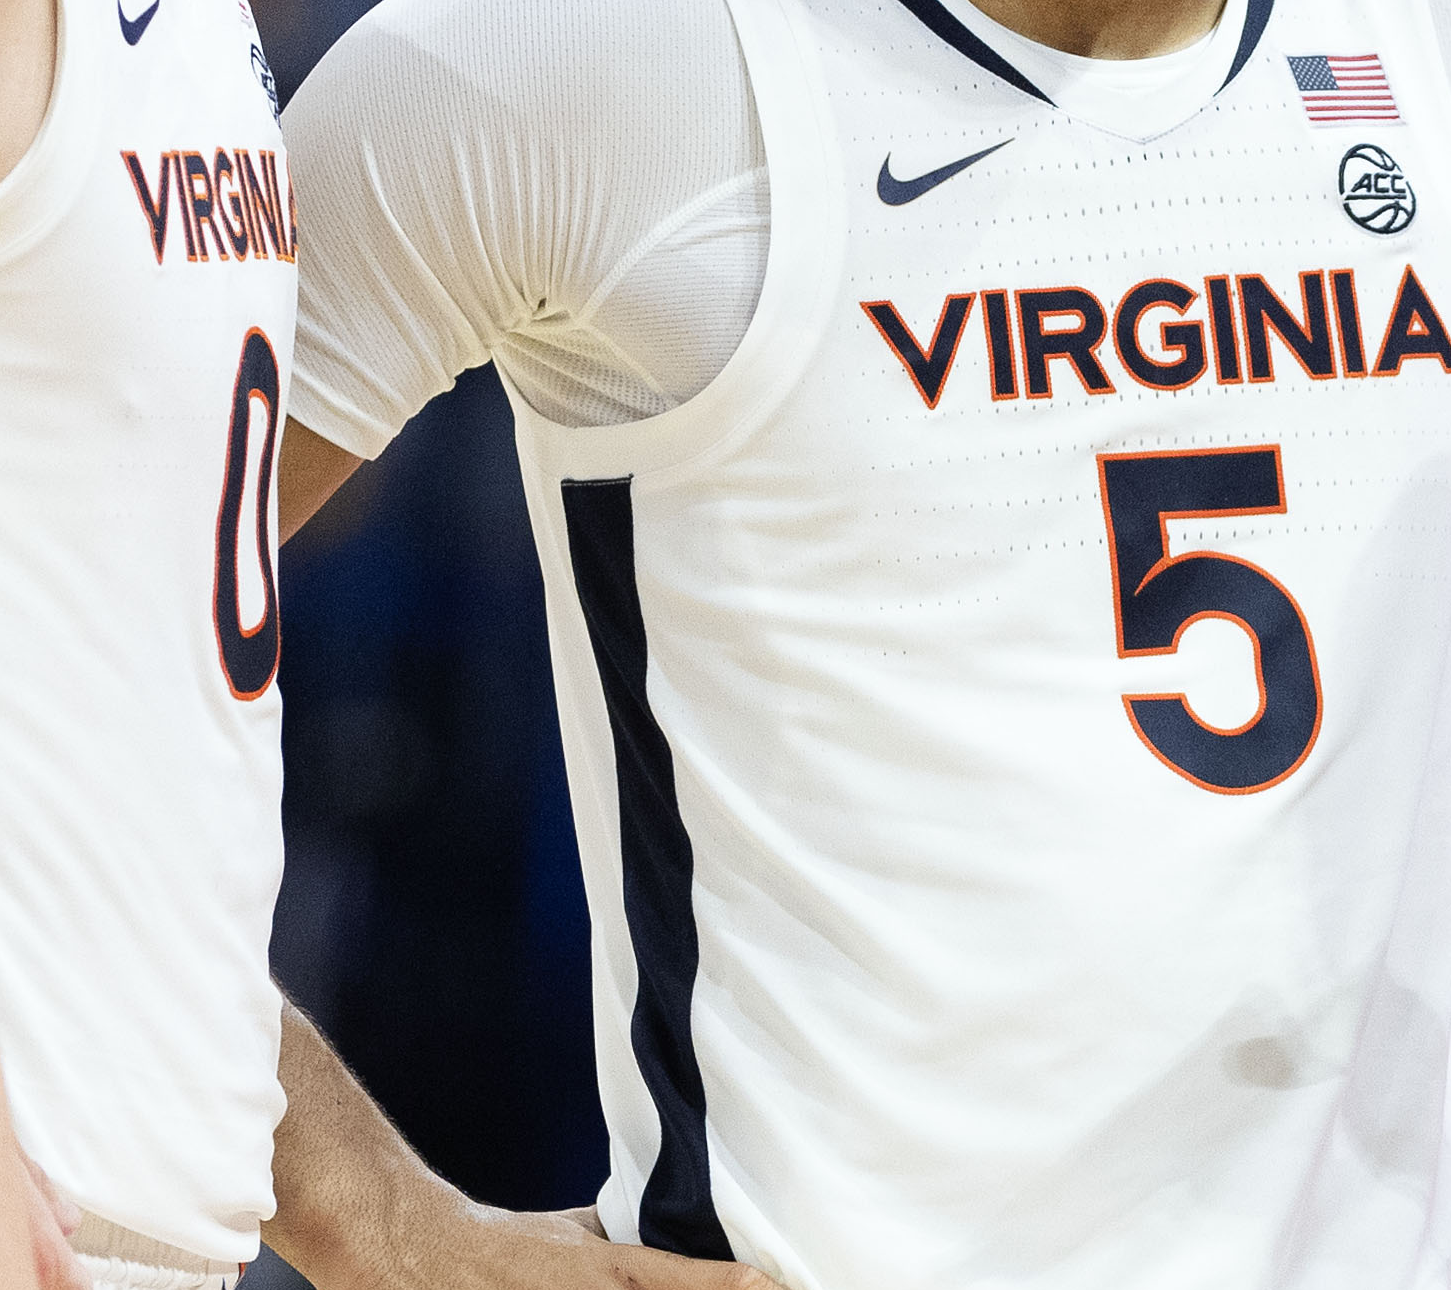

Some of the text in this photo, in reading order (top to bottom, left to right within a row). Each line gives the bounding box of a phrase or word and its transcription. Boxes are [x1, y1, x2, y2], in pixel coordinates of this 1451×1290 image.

[1350, 172, 1408, 195] ACC
[211, 326, 281, 702] 0
[1095, 443, 1325, 796] 5
